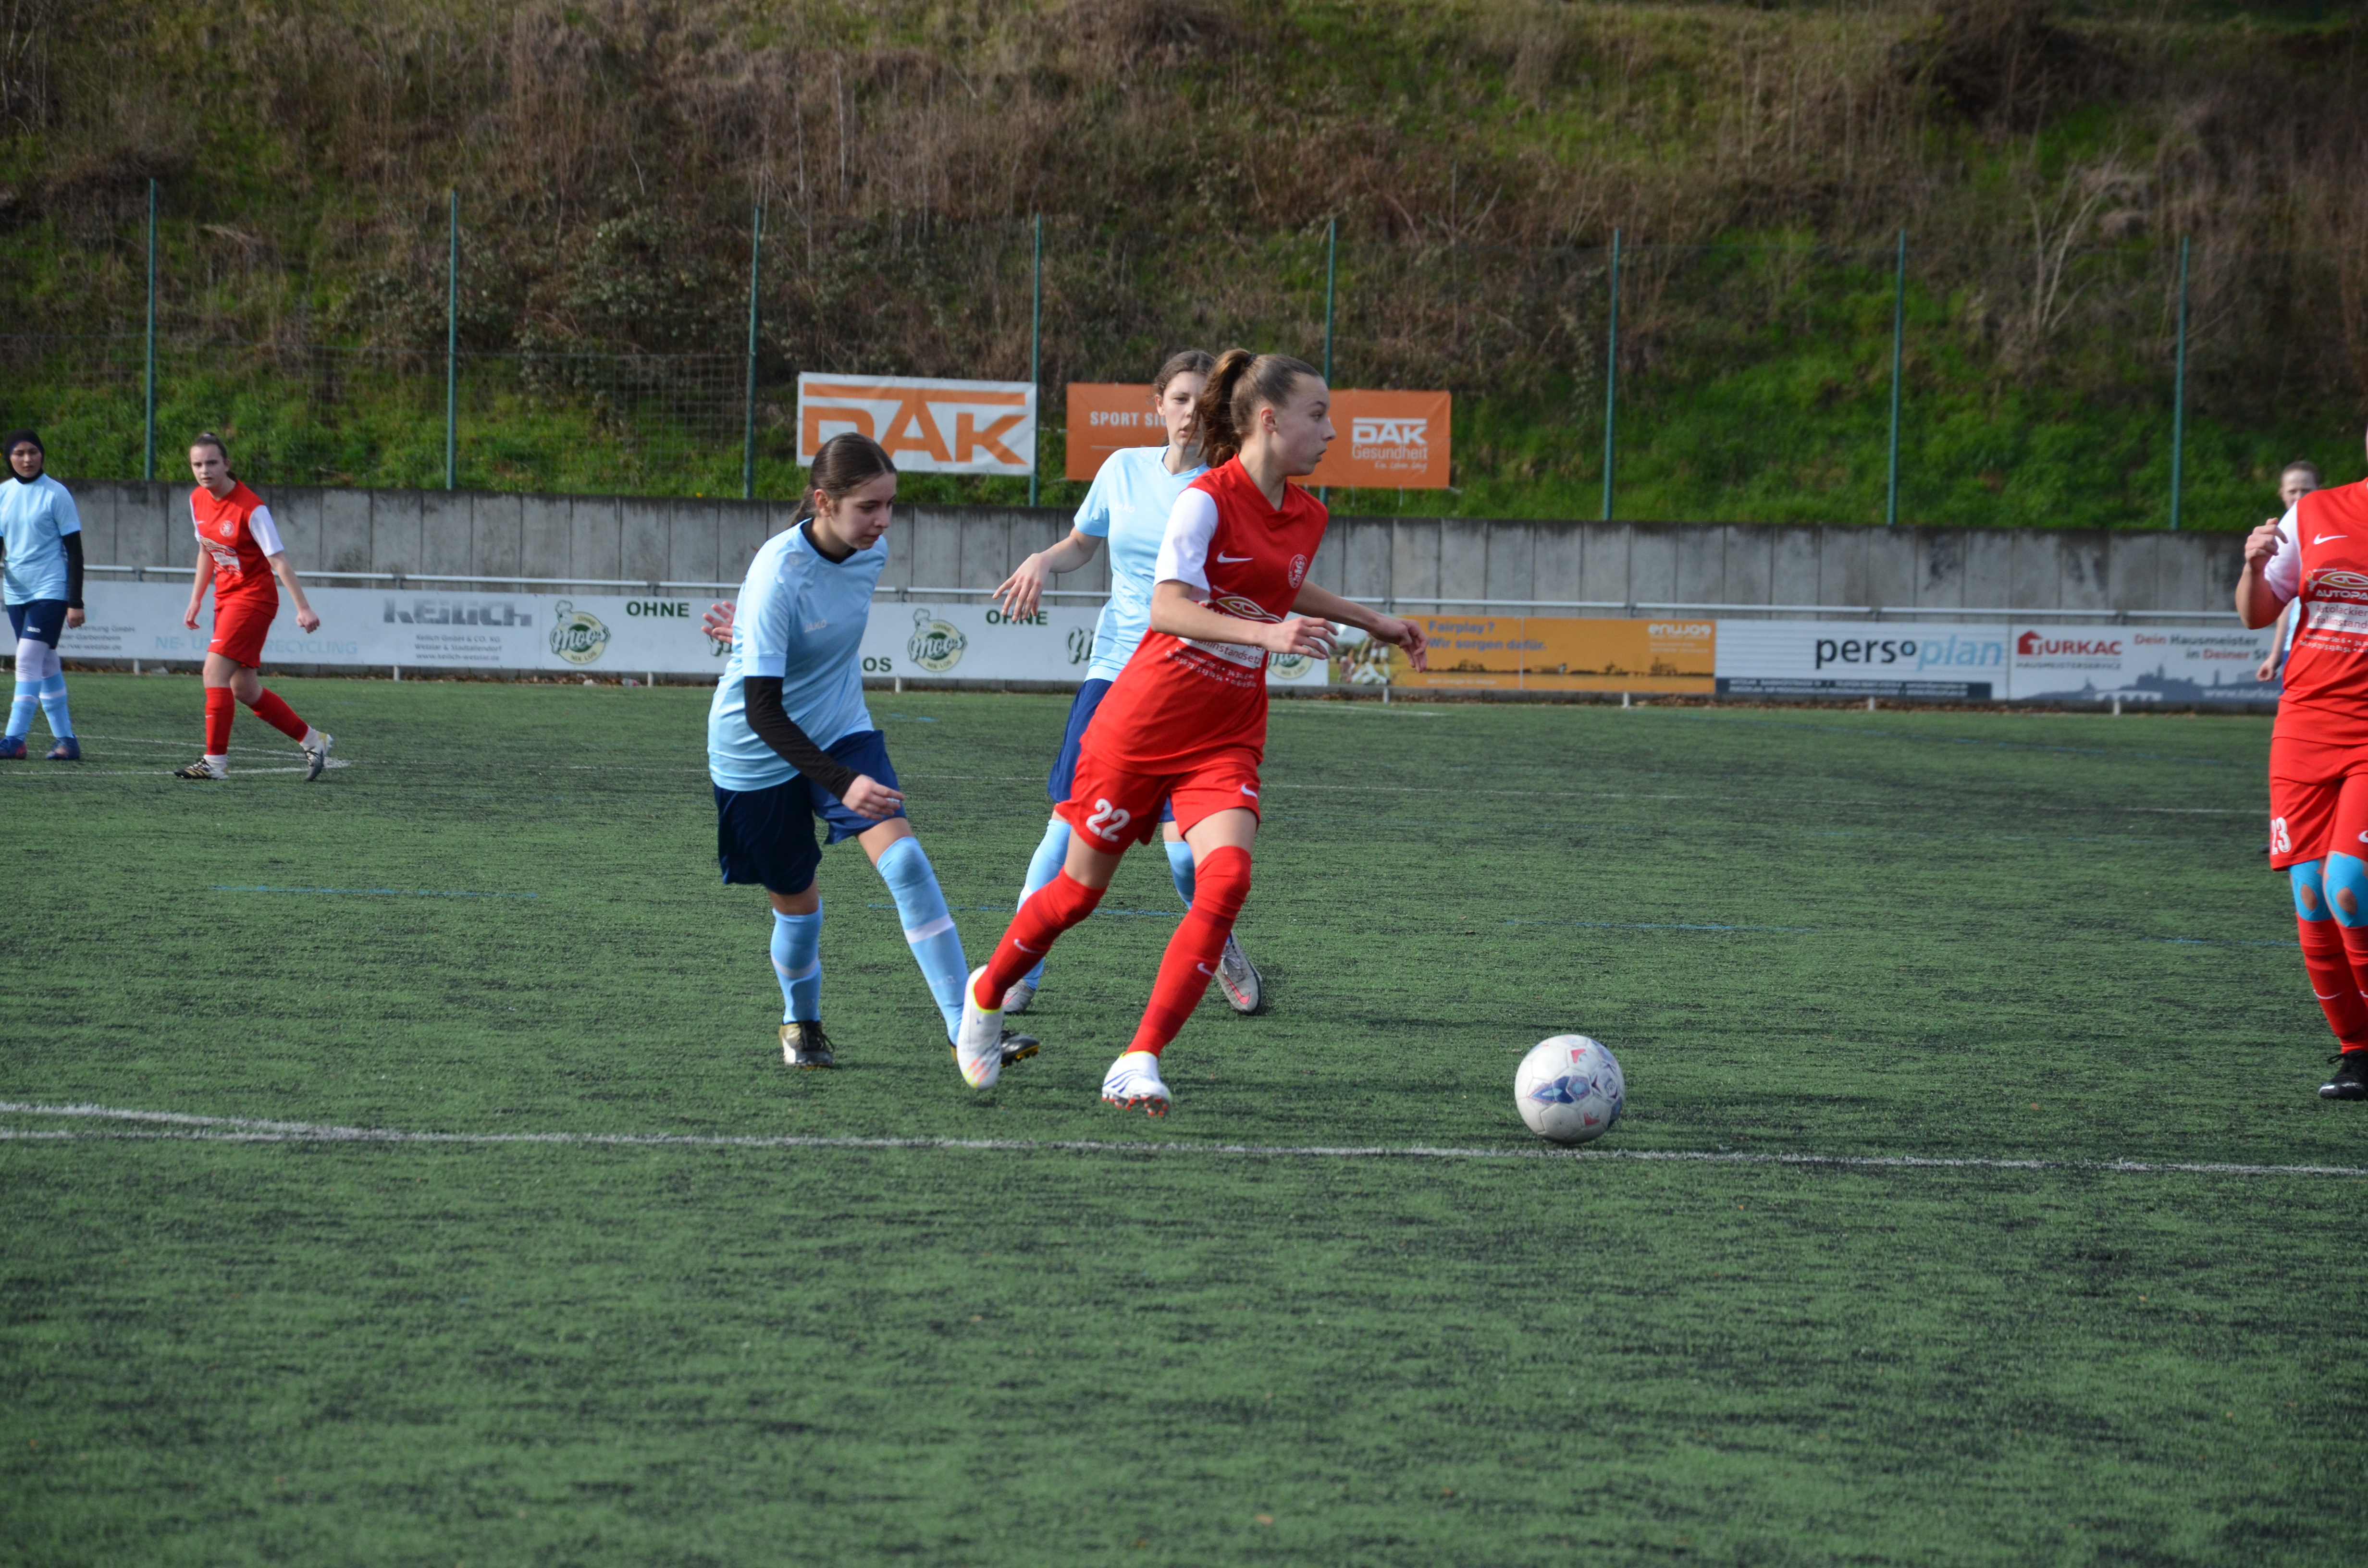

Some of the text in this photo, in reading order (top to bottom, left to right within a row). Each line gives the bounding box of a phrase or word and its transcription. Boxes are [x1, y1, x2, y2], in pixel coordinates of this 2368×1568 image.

[802, 382, 1028, 465] DAK
[1090, 411, 1139, 426] SPORT
[1352, 417, 1428, 445] DAK
[1352, 443, 1429, 460] Gesundheit
[627, 601, 690, 617] OHNE
[804, 620, 827, 633] JAKO
[1429, 637, 1452, 648] Wir
[1456, 639, 1504, 652] sorgen
[2134, 634, 2258, 645] Dein Hausmeister
[2186, 649, 2199, 659] in
[2203, 649, 2250, 660] Deiner
[863, 657, 892, 672] OS
[1085, 798, 1130, 842] 22
